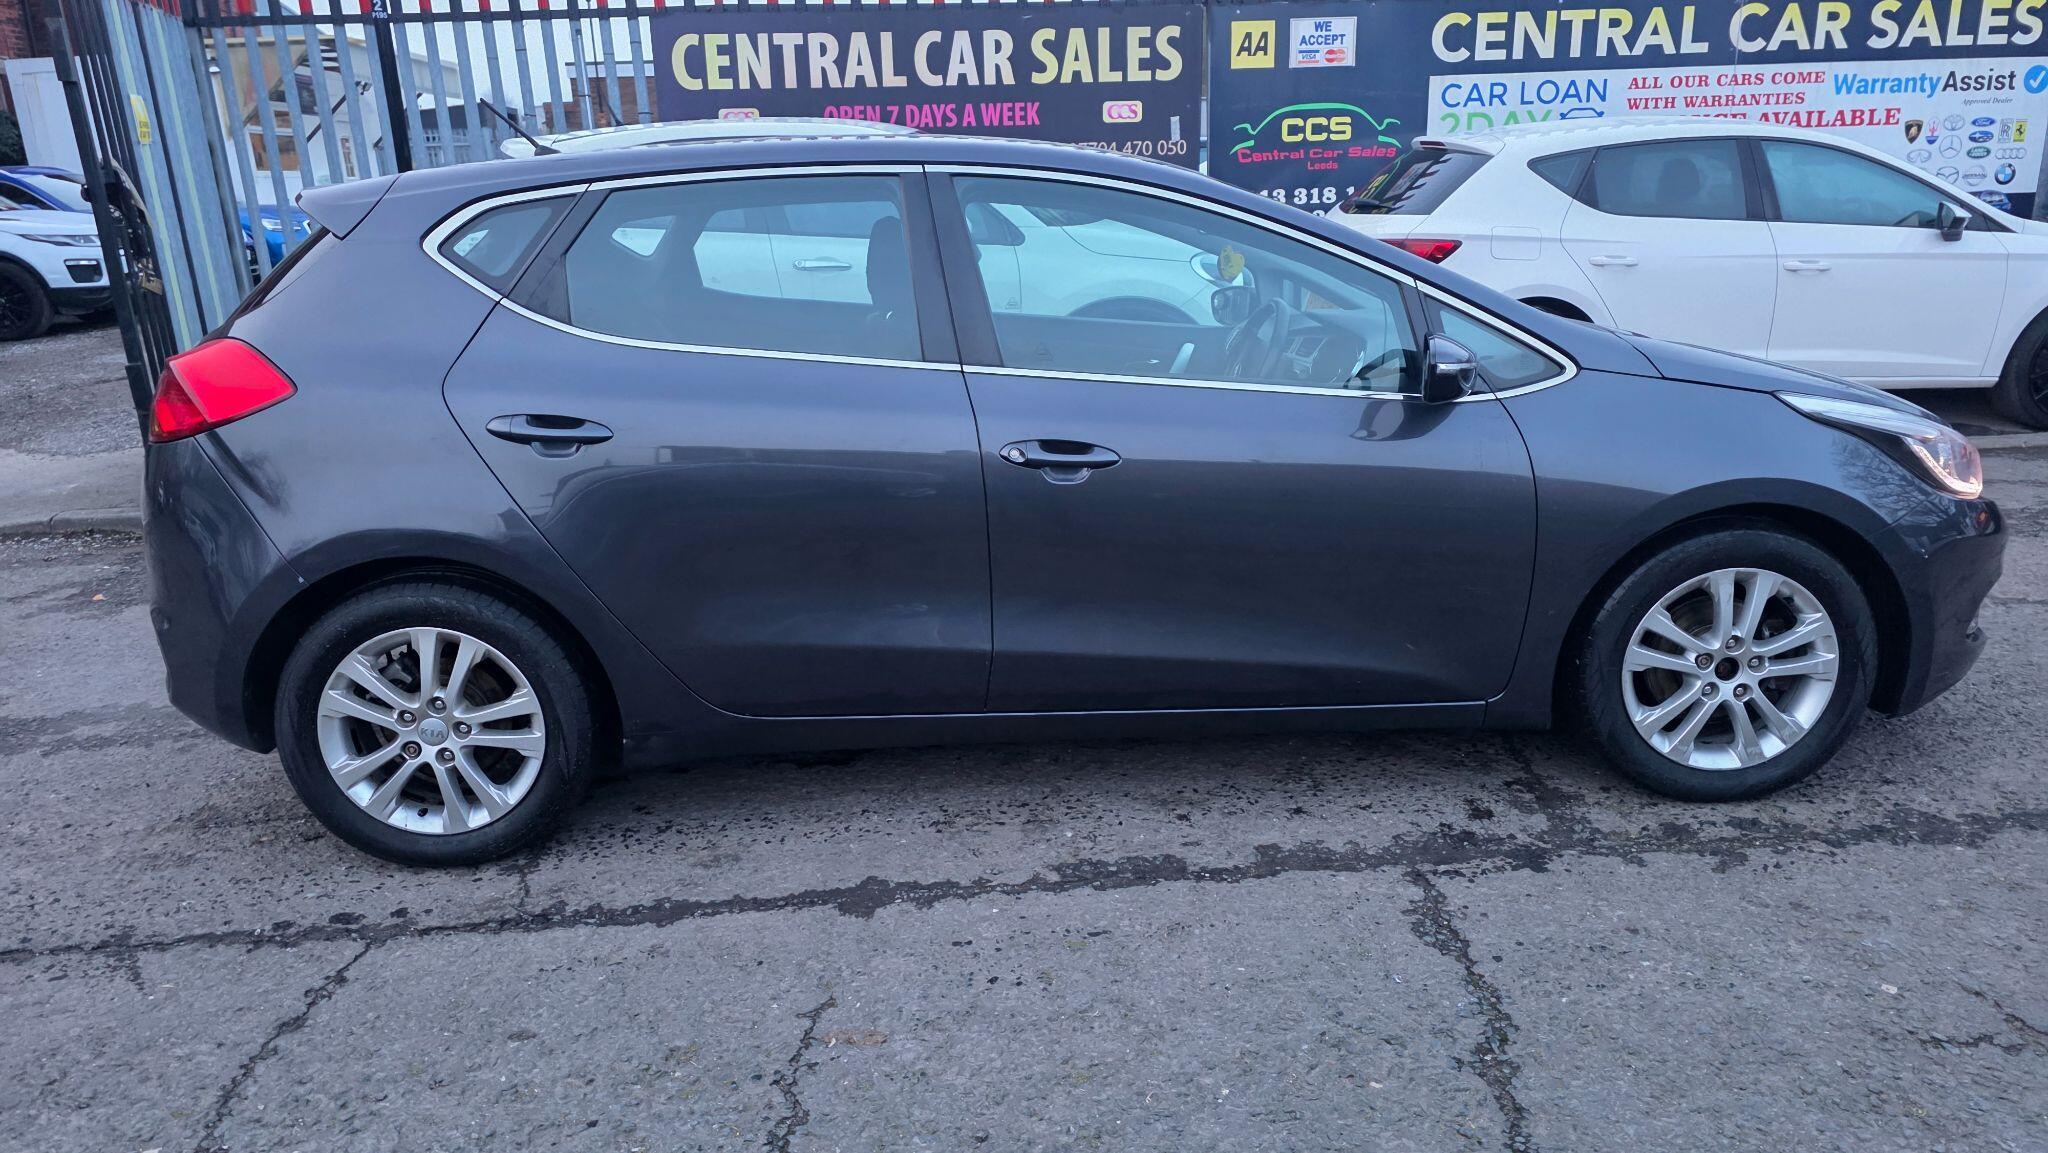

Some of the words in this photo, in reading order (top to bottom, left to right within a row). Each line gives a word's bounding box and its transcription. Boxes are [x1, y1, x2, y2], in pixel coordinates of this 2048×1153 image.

[1314, 21, 1332, 32] WE
[1431, 6, 1709, 62] CENTRAL
[1729, 2, 1851, 52] CAR
[1866, 0, 2047, 49] SALES
[1236, 31, 1268, 57] AA
[1299, 33, 1346, 46] ACCEPT
[671, 31, 908, 90] CENTRAL
[914, 30, 1015, 87] CAR
[1031, 25, 1183, 84] SALES
[1628, 75, 1663, 90] ALL
[1670, 74, 1710, 88] OUR
[1716, 72, 1765, 87] CARS
[1771, 70, 1826, 84] COME
[1833, 68, 2017, 99] WarrantyAssist
[1441, 83, 1508, 108] CAR
[1520, 78, 1608, 105] LOAN
[1627, 96, 1676, 110] WITH
[1683, 91, 1806, 109] WARRANTIES
[887, 106, 899, 124] 7
[905, 103, 956, 127] DAYS
[962, 103, 977, 127] A
[980, 102, 1040, 126] WEEK
[1758, 107, 1901, 129] AVAILABLE
[1281, 116, 1352, 142] CCS
[1123, 141, 1152, 156] 470
[1158, 140, 1187, 155] 050
[1237, 148, 1304, 164] Central
[1309, 148, 1343, 158] Car
[1348, 145, 1397, 158] Sales
[1307, 161, 1338, 170] Leeds
[1294, 186, 1337, 205] 318
[420, 727, 445, 739] KIA
